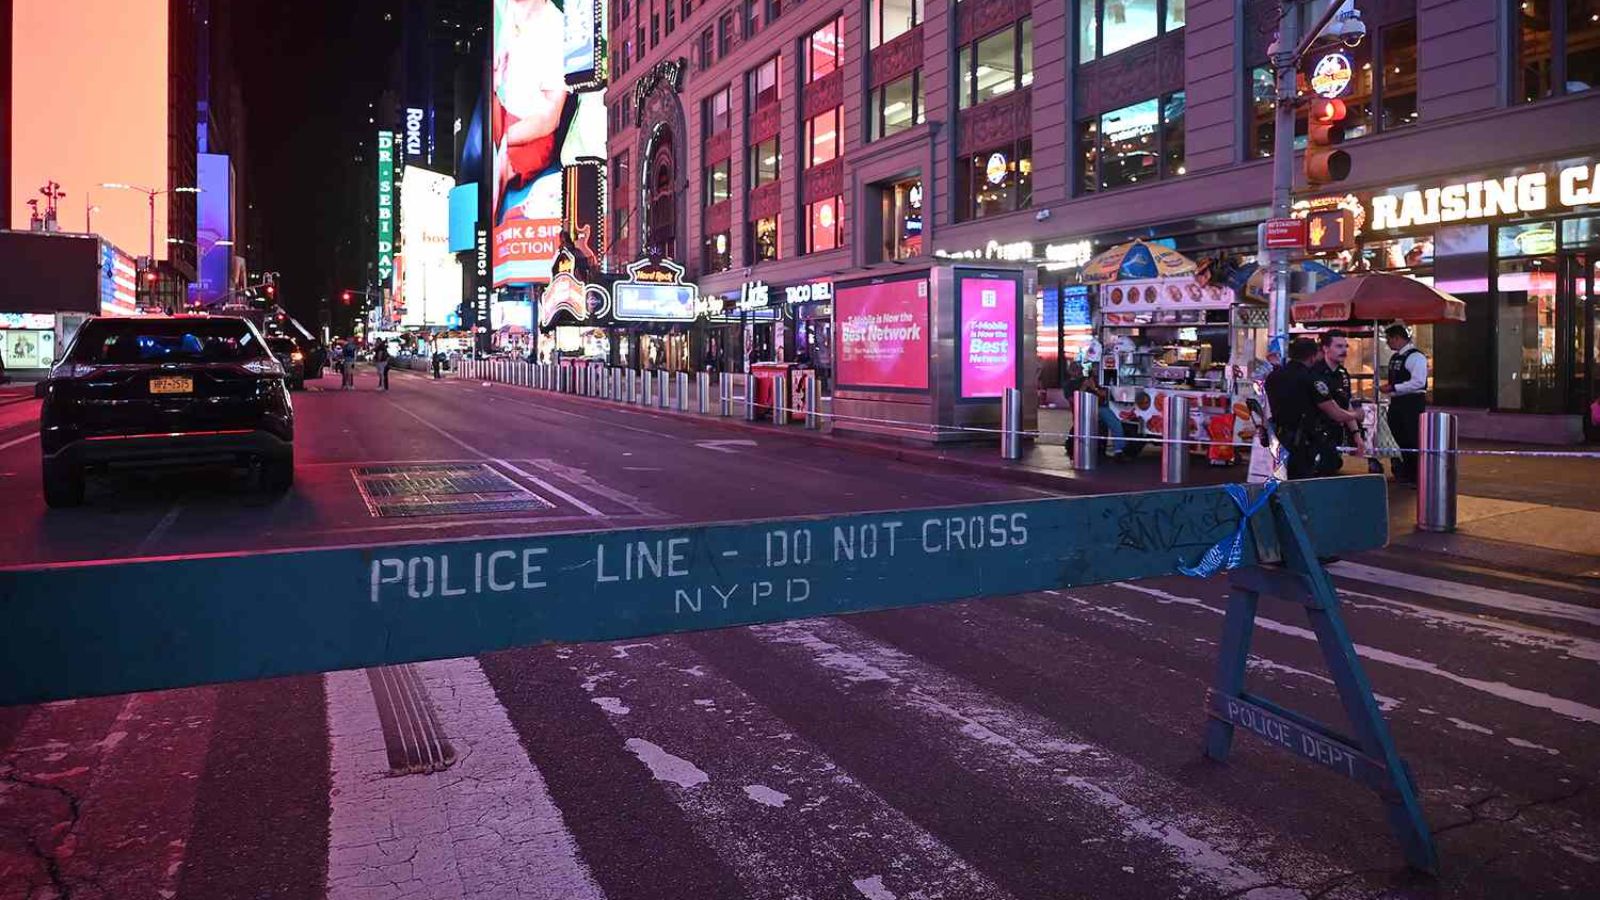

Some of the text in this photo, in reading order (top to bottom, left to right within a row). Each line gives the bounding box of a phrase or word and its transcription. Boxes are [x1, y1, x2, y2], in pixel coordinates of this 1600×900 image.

[378, 180, 392, 233] SEBI
[1371, 172, 1547, 230] RAISING
[477, 230, 487, 276] SQUARE
[477, 286, 487, 321] TIMES
[785, 281, 832, 304] TACO BEL
[868, 323, 921, 341] Network
[970, 338, 1009, 353] Best
[371, 548, 548, 602] POLICE
[597, 538, 690, 582] LINE
[766, 529, 811, 567] DO
[834, 521, 902, 562] NOT
[922, 513, 1028, 552] CROSS
[675, 578, 810, 613] NYPD
[1228, 701, 1358, 777] POLICE DEPT
